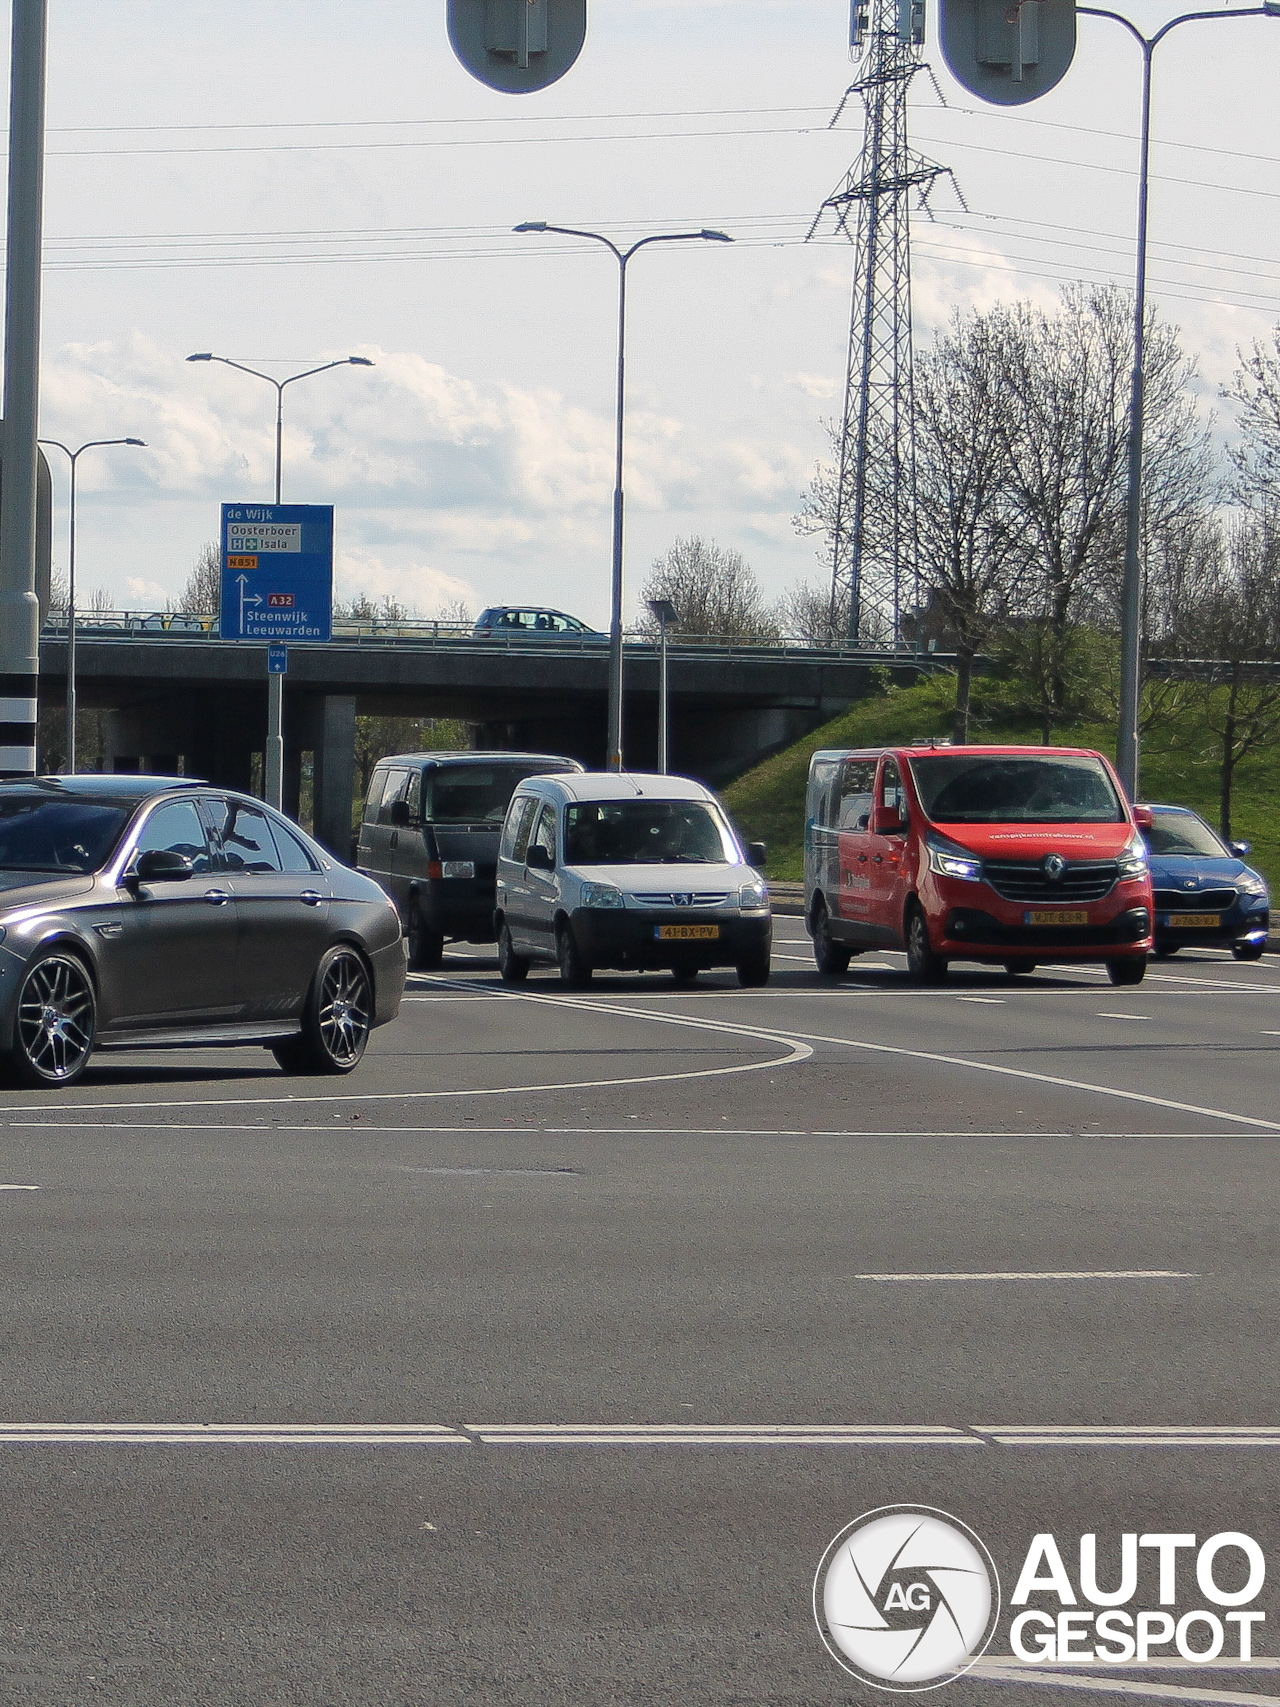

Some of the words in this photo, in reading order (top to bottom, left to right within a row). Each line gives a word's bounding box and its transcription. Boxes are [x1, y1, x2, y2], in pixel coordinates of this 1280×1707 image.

[227, 509, 242, 519] de
[246, 509, 273, 522] Wijk
[231, 526, 297, 536] Oosterboer
[260, 540, 287, 549] Isala
[247, 611, 308, 624] Steenwijk
[246, 625, 320, 636] Leeuwarden
[665, 927, 714, 937] 41-BX-PV
